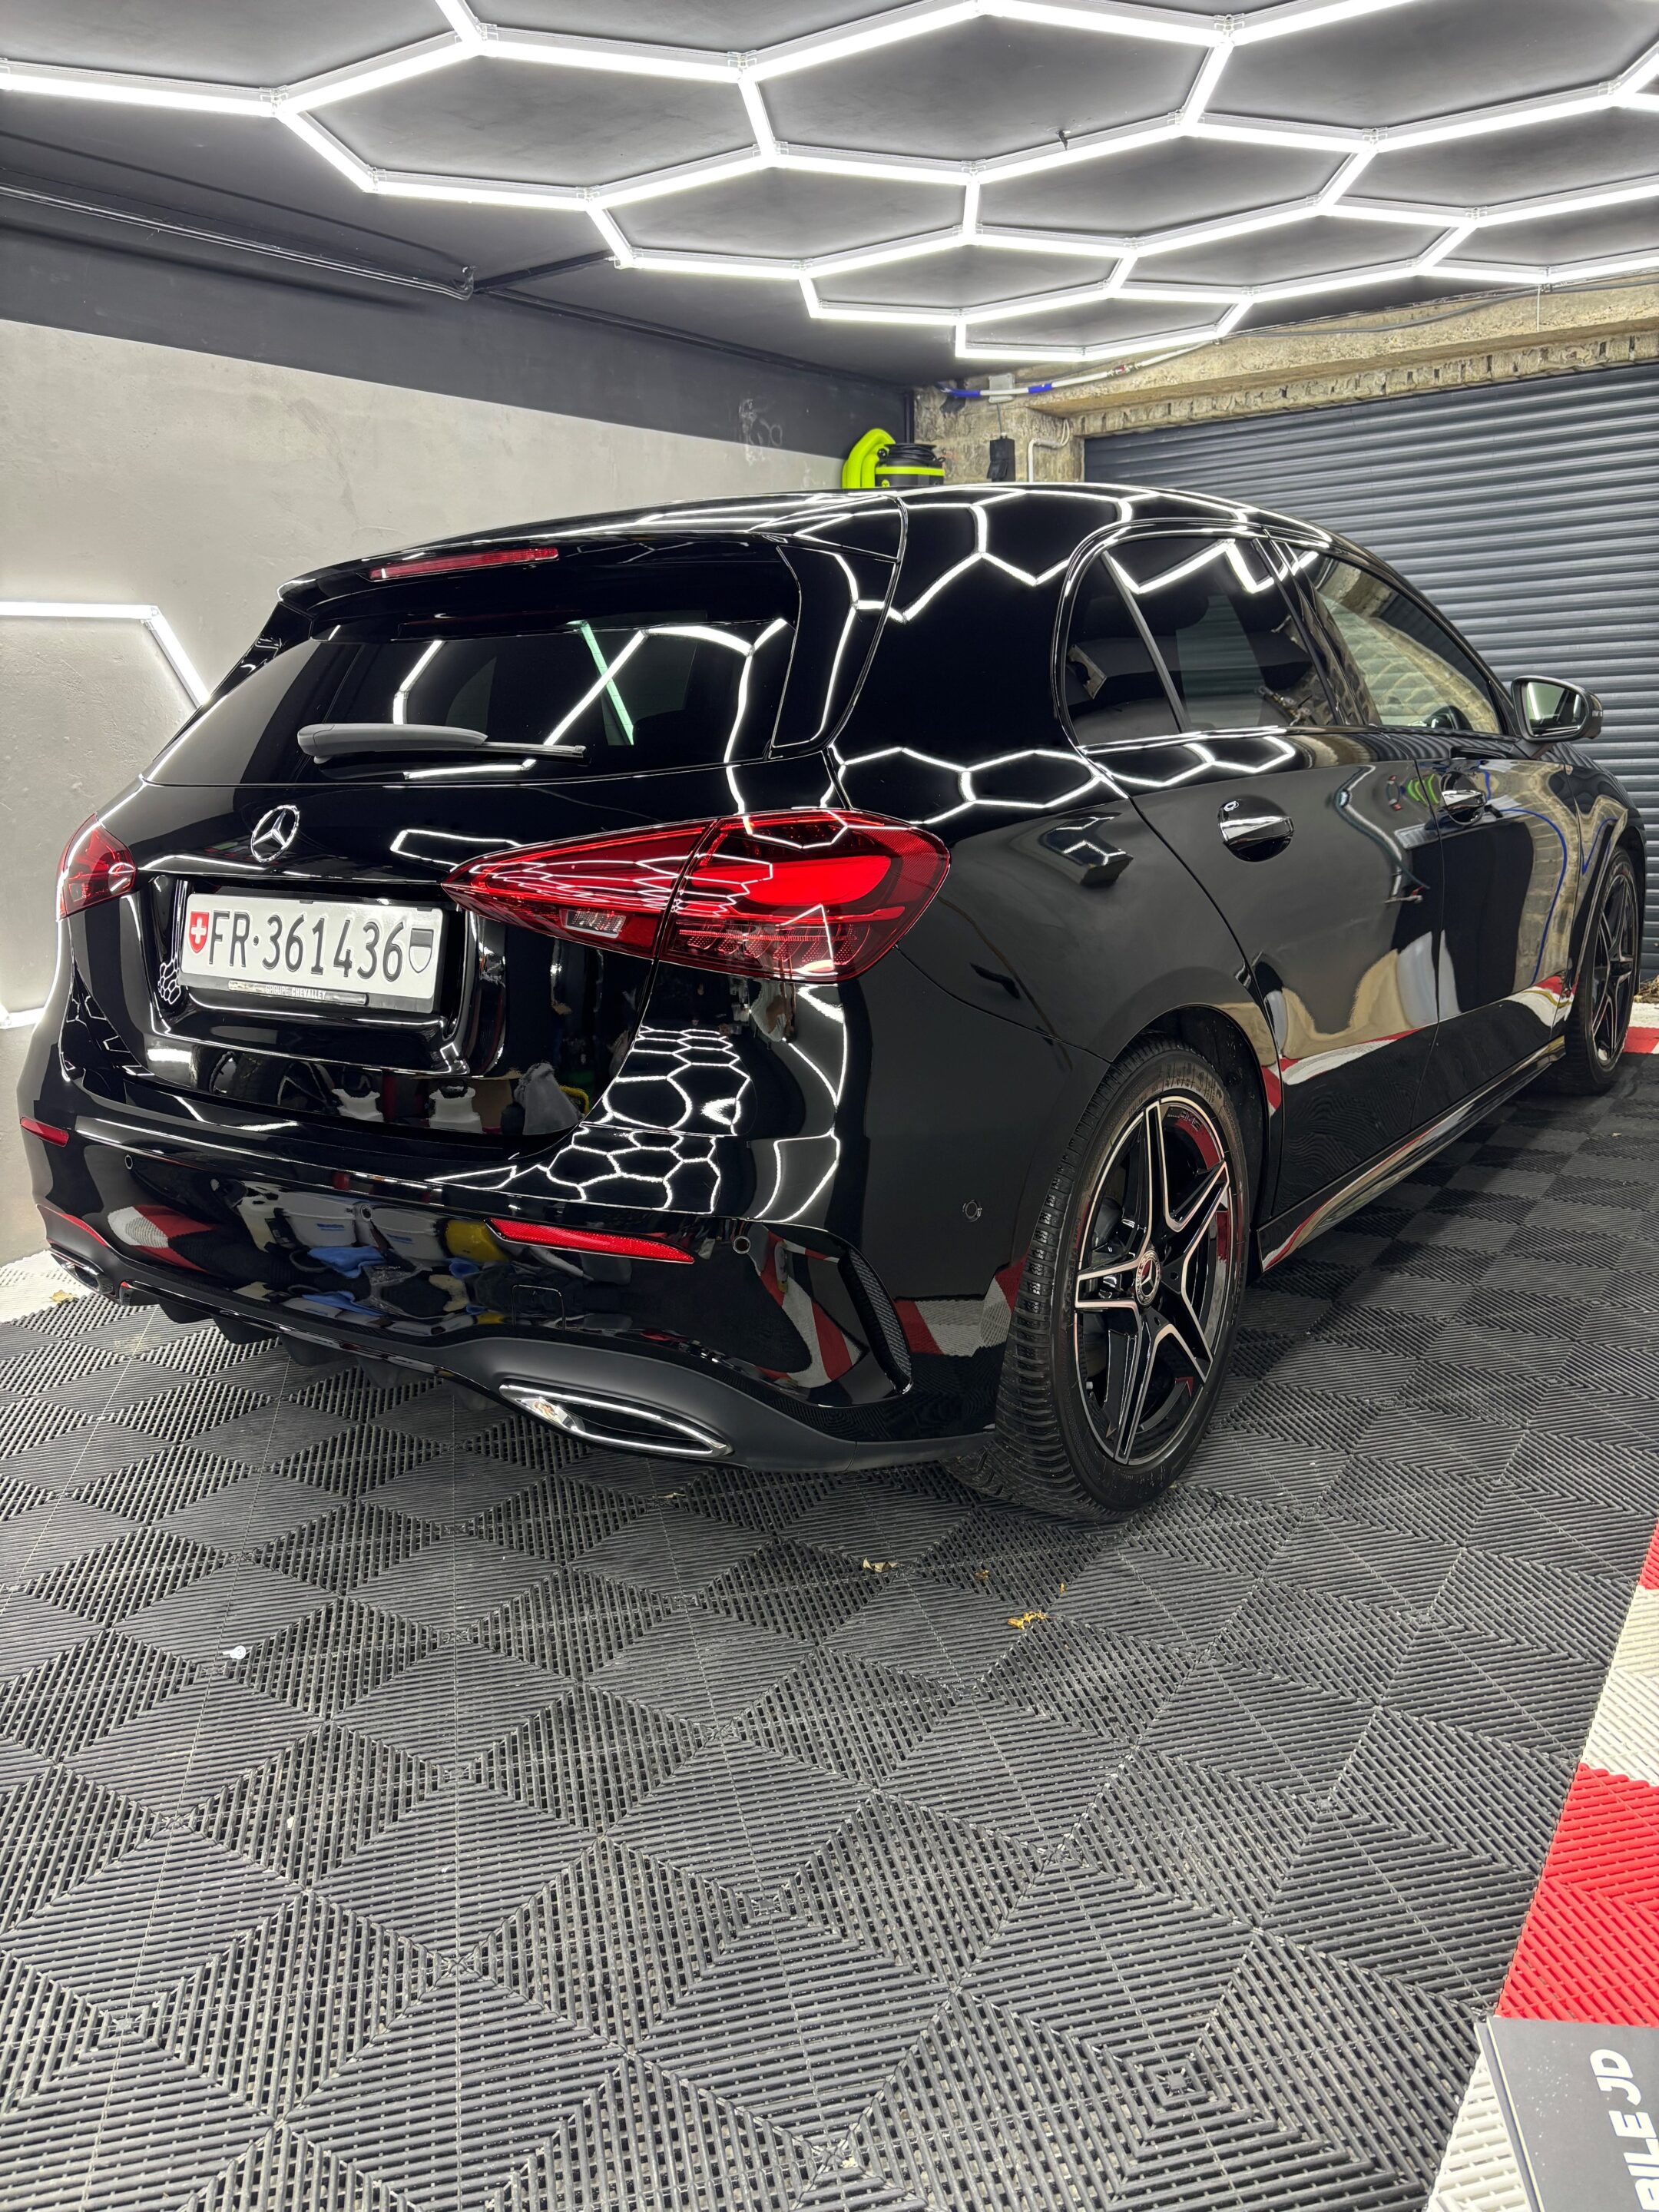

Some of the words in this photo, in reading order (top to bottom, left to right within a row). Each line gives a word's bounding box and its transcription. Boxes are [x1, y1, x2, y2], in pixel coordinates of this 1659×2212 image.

[264, 984, 290, 996] GROUPE
[291, 987, 326, 1000] CHEVALLEY
[1589, 2048, 1641, 2106] JD
